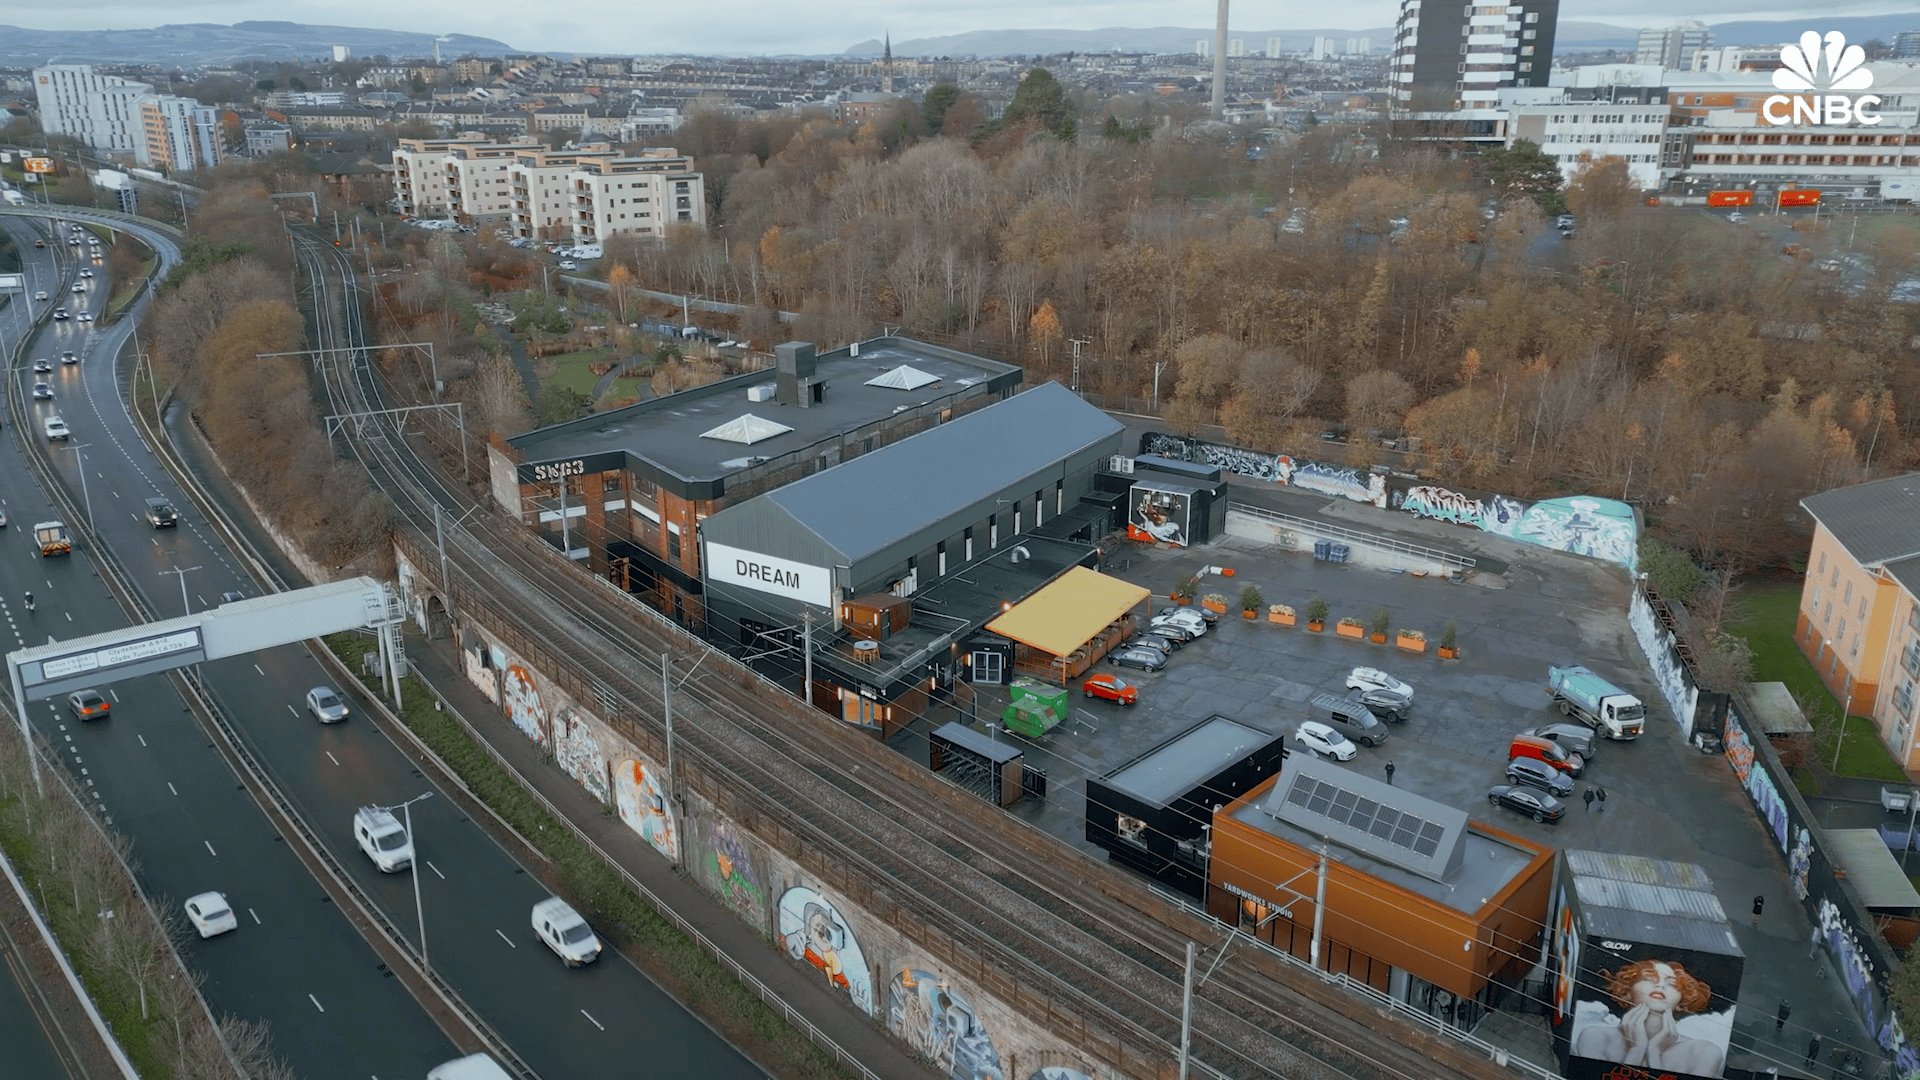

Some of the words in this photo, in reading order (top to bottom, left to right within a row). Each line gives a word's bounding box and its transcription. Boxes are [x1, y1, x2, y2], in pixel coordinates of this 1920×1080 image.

[535, 460, 584, 480] SWG3
[736, 559, 800, 589] DREAM
[108, 642, 146, 656] Clydebank
[110, 654, 132, 664] Clyde
[133, 648, 158, 659] Tunnel
[1224, 881, 1266, 906] YARDWORKS
[1268, 901, 1293, 918] STUDIO
[1601, 941, 1632, 951] GLOW
